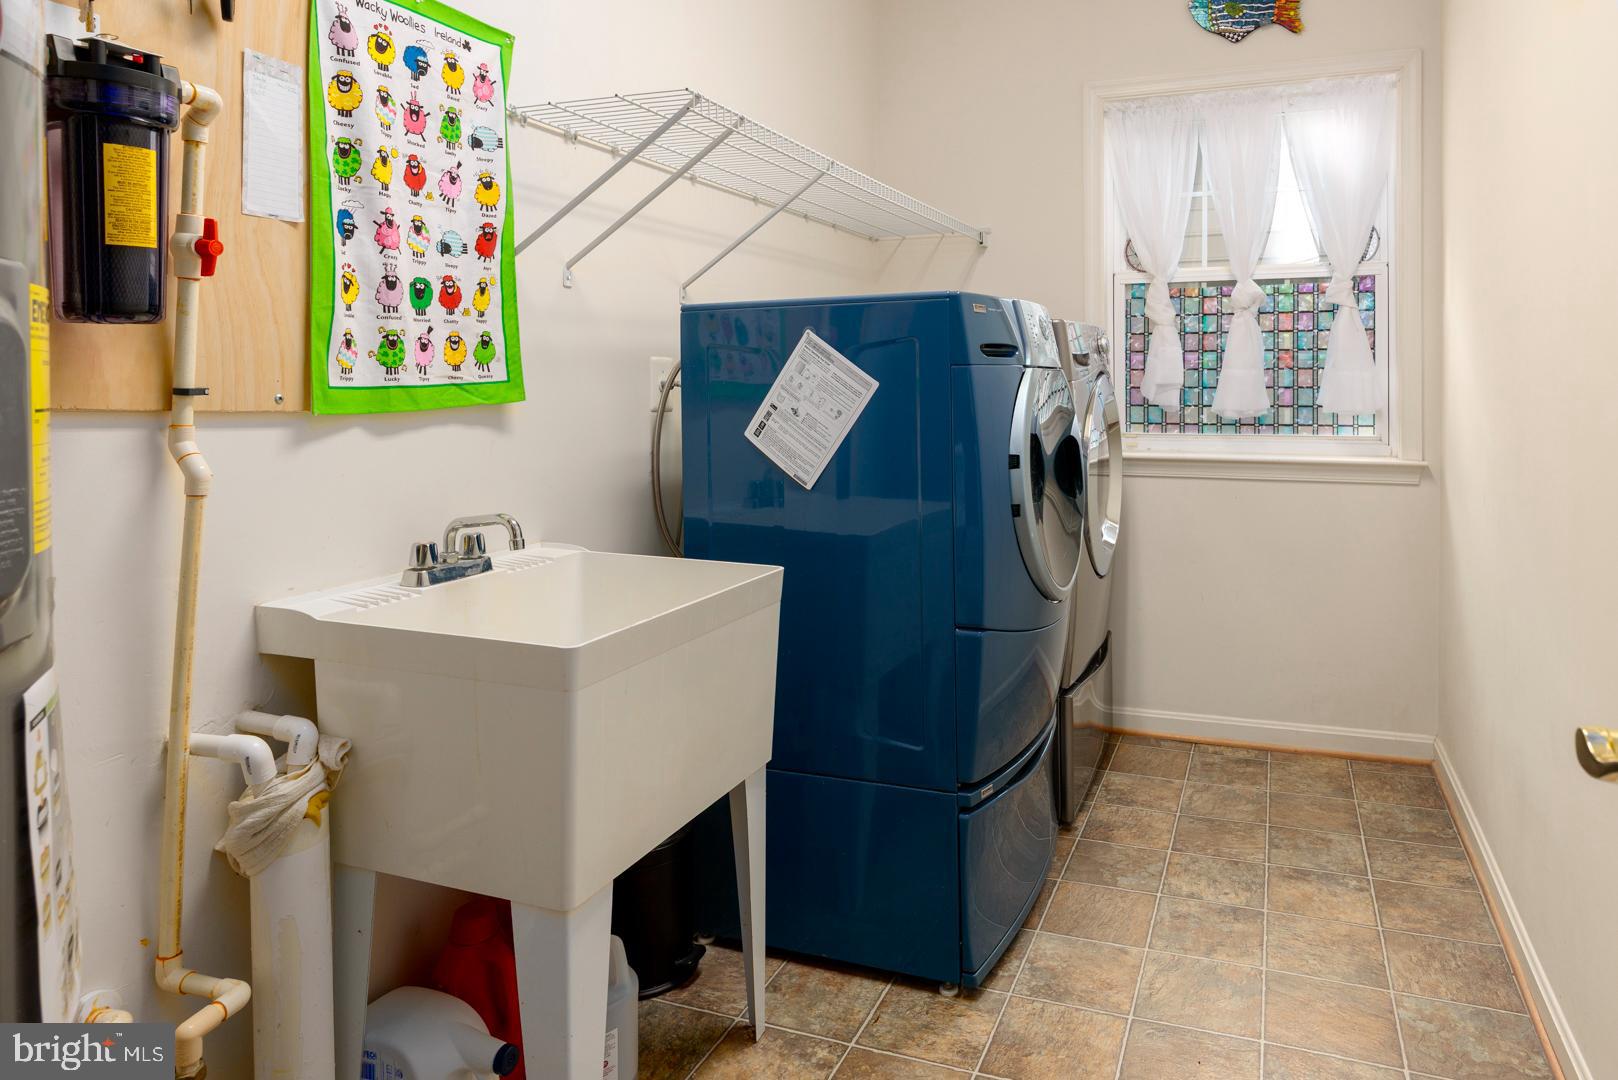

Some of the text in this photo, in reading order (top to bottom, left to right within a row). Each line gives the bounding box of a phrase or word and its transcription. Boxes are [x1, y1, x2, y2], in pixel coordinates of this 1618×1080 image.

[355, 0, 461, 48] Wacky Woollies Ireland
[329, 55, 361, 67] Confused
[332, 120, 355, 129] Cheesy
[376, 314, 402, 322] Confused
